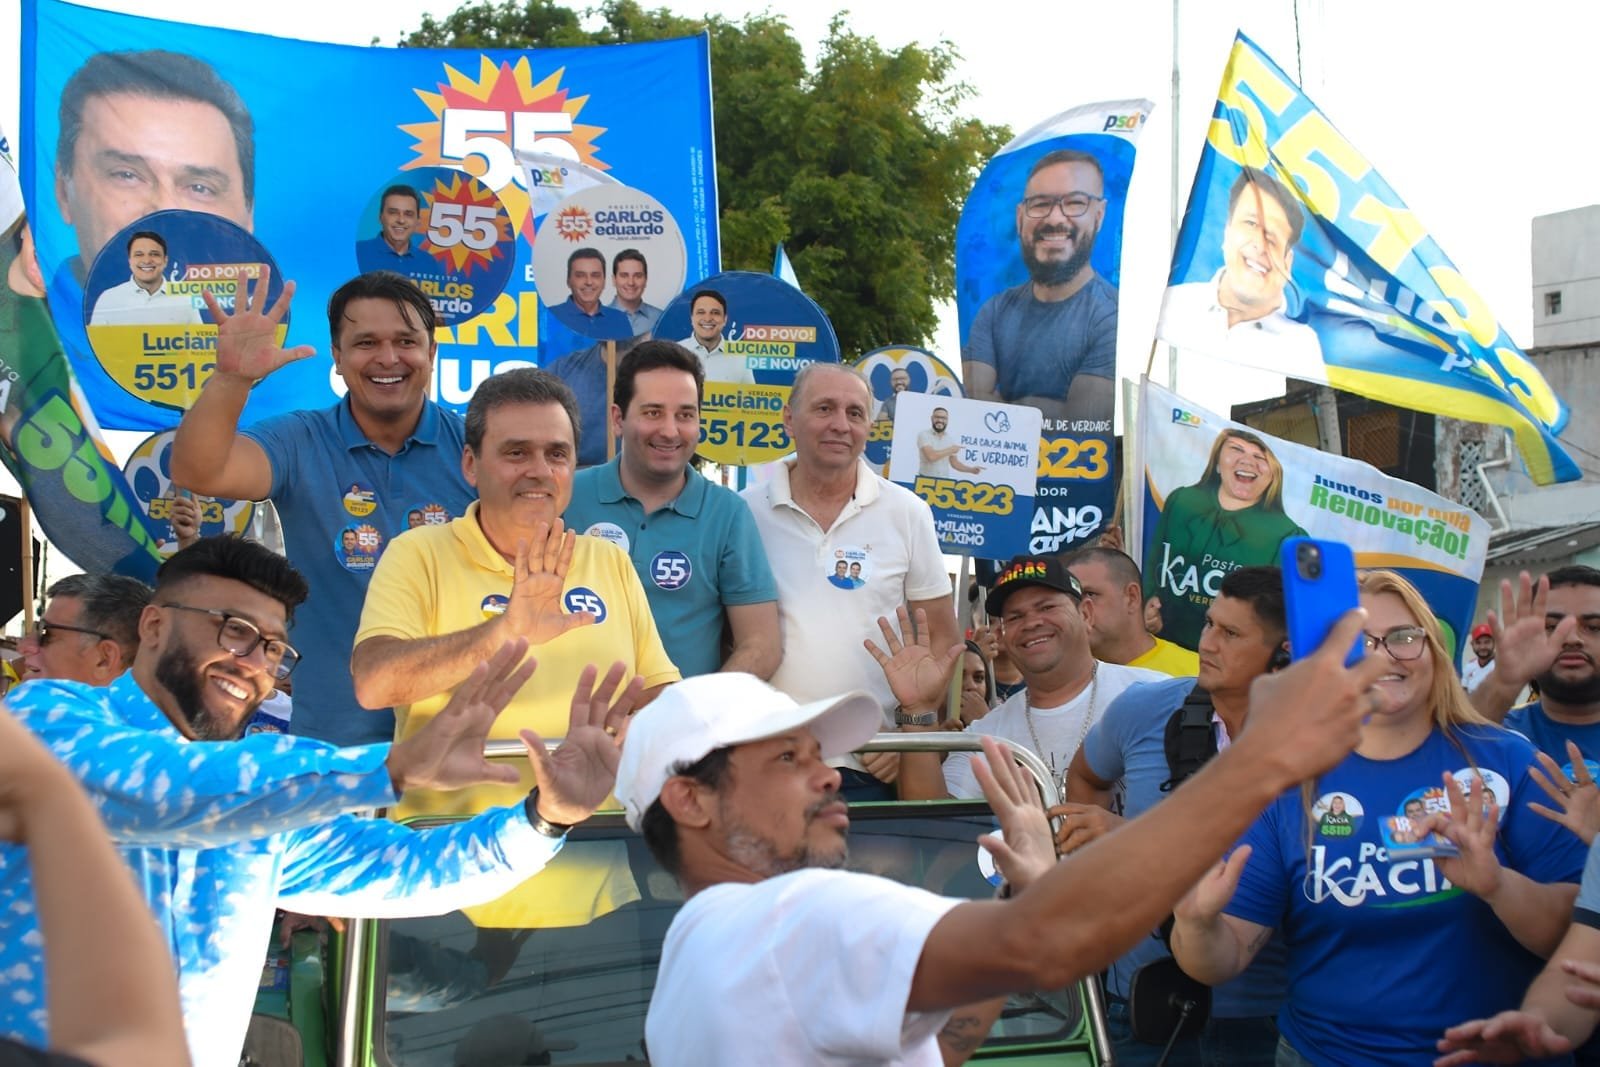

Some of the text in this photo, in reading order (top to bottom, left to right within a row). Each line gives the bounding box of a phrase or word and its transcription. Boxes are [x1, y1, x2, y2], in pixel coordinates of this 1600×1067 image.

[440, 108, 581, 192] 55
[561, 215, 588, 232] 55
[595, 210, 664, 223] CARLOS
[427, 202, 498, 250] 55
[594, 223, 664, 235] eduardo
[189, 267, 212, 279] DO
[170, 282, 237, 294] LUCIANO
[430, 298, 473, 314] ardo
[143, 332, 218, 350] Lucian
[747, 328, 767, 339] DO
[770, 328, 815, 341] POVO!
[728, 343, 790, 356] LUCIANO
[748, 358, 767, 369] DE
[1056, 420, 1069, 432] DE
[1071, 421, 1111, 433] VERDADE
[961, 435, 978, 446] PELA
[979, 437, 1002, 449] CAUSA
[965, 449, 1030, 468] DE VERDADE!
[914, 477, 1014, 515] 55323
[1314, 474, 1383, 504] Juntos
[1387, 495, 1425, 517] por
[1310, 484, 1470, 560] Renovação!
[358, 532, 378, 546] 55
[655, 558, 687, 581] 55
[570, 594, 603, 617] 55
